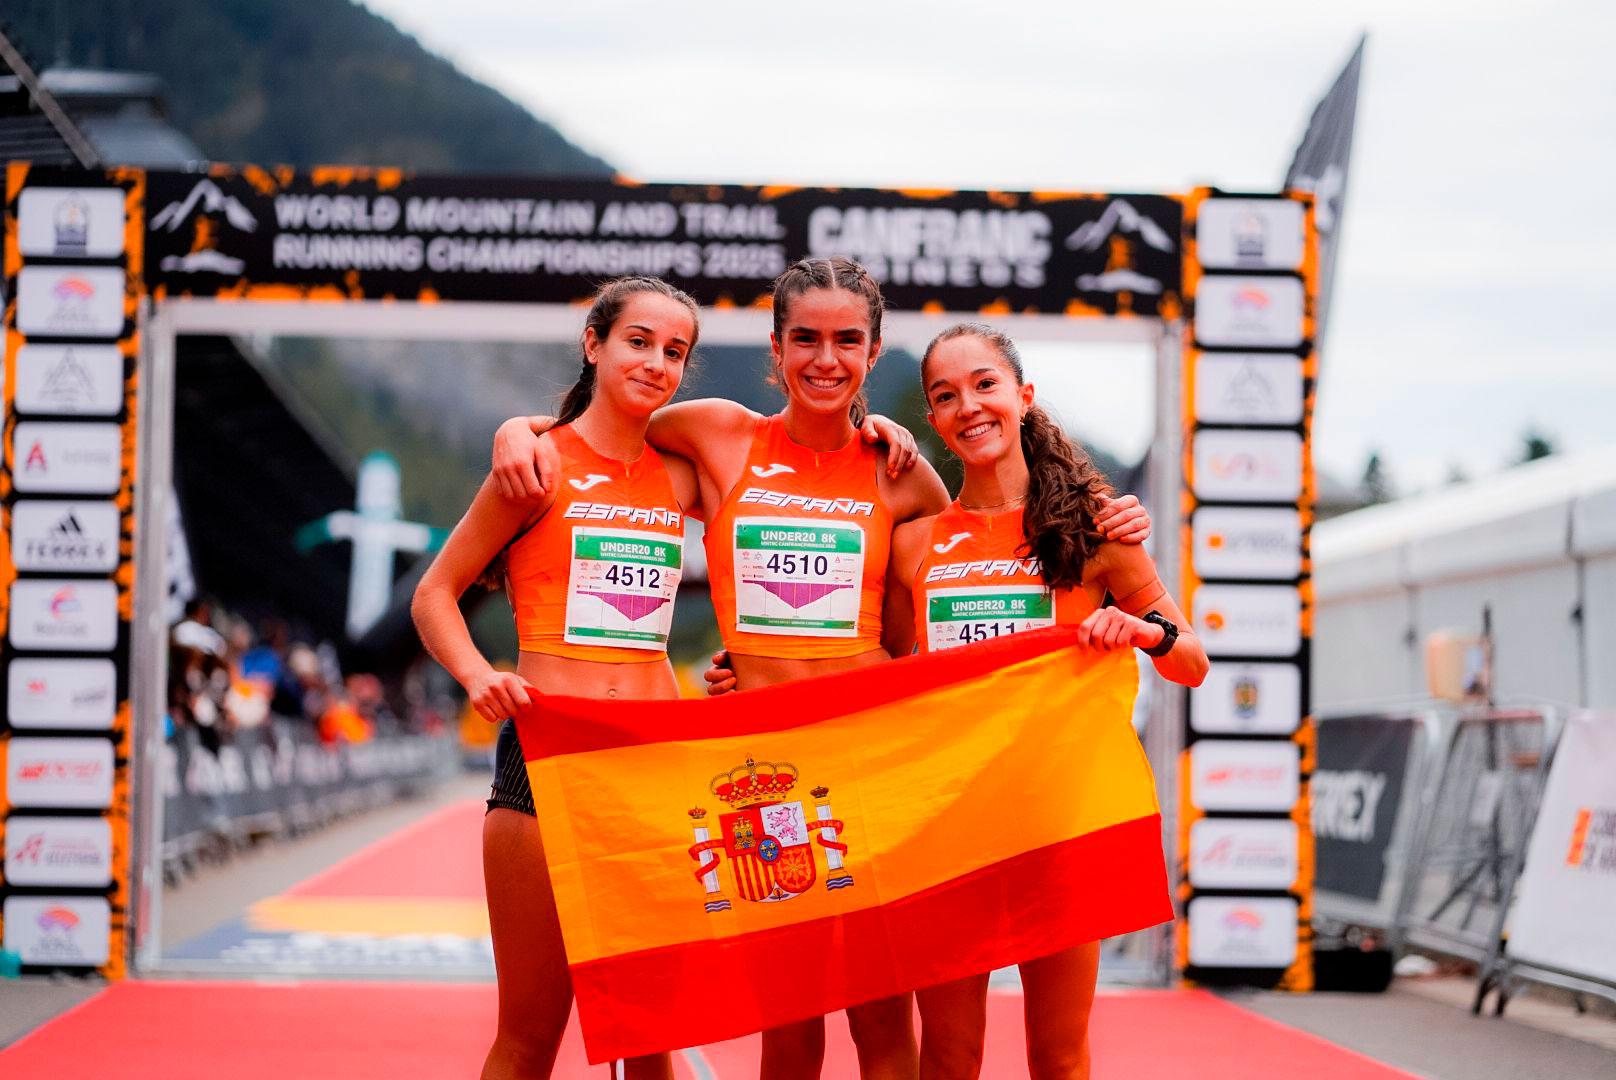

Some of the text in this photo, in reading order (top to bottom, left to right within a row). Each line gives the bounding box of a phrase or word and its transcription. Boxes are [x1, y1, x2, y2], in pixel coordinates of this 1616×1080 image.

[275, 194, 783, 240] WORLD MOUNTAIN AND TRAIL
[808, 206, 1051, 262] CANFRANC
[274, 233, 785, 279] RUNNING CHAMPIONSHIPS 2025
[564, 502, 680, 528] ESPAÑA
[738, 488, 875, 516] ESPAÑA
[600, 542, 666, 557] UNDER20 8K
[761, 531, 837, 543] UNDER20 8K
[605, 565, 660, 589] 4512
[767, 554, 828, 575] 4510
[925, 557, 1043, 583] ESPAÑ
[952, 600, 1026, 611] UNDER20 8K
